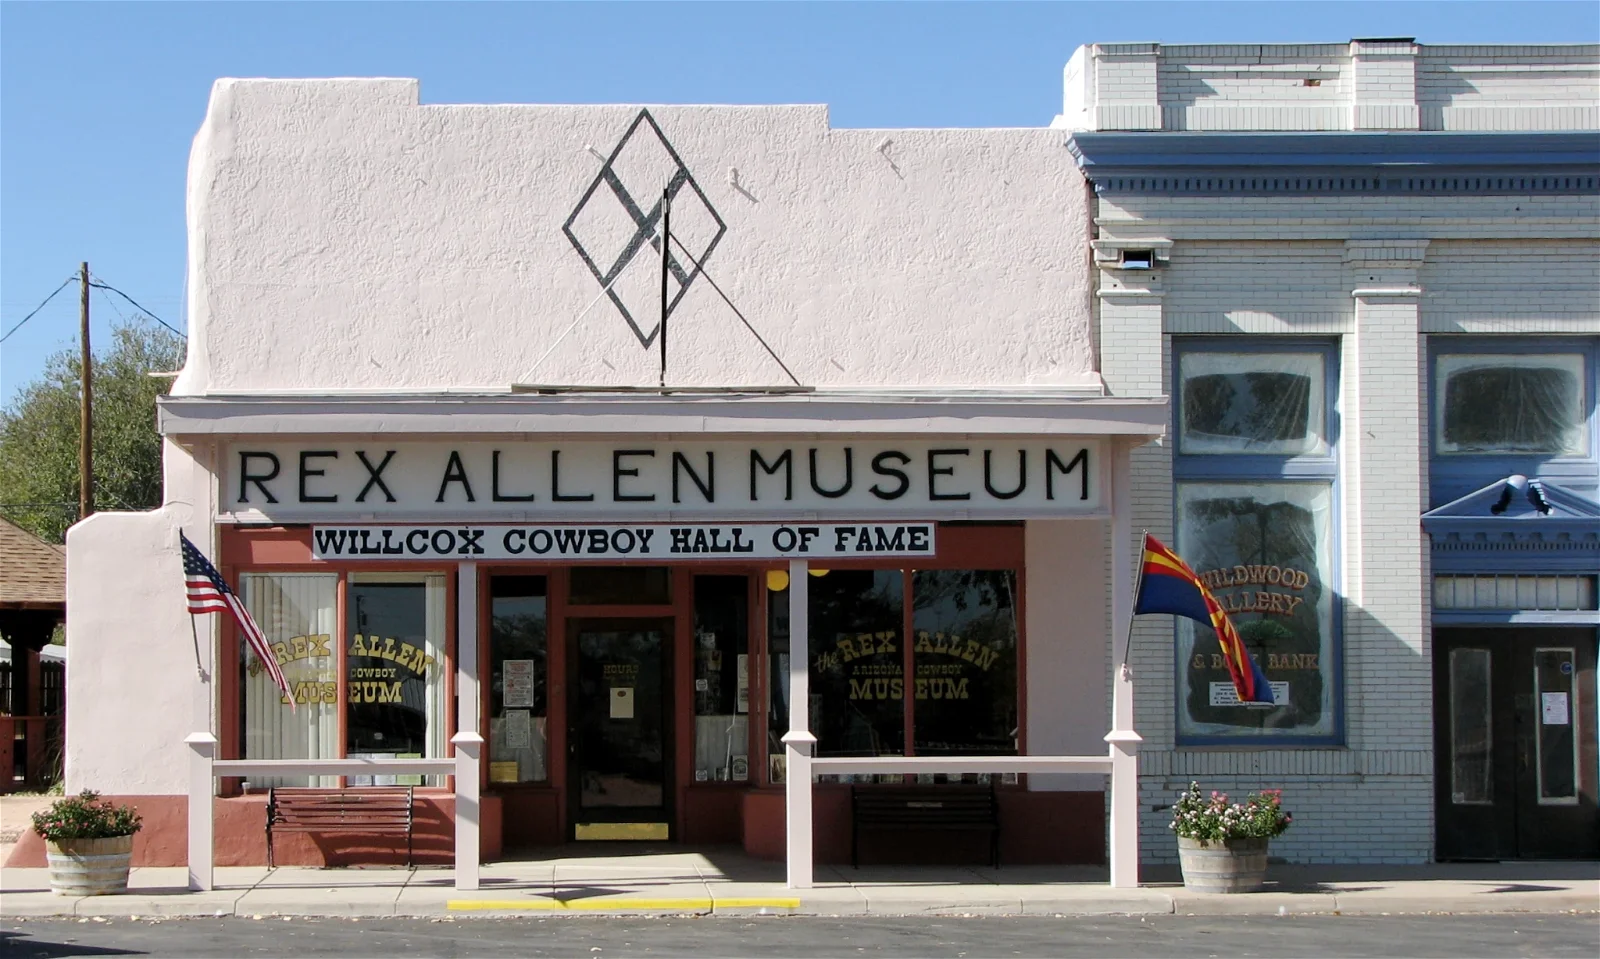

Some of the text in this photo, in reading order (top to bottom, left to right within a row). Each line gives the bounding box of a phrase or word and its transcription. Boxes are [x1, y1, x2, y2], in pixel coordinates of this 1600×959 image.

[237, 447, 1089, 503] REX ALLEN MUSEUM
[314, 526, 929, 554] WILLCOX COWBOY HALL OF FAME
[1214, 591, 1303, 616] ALLERY
[270, 633, 331, 667] REX
[347, 633, 435, 676] ALLEN
[814, 630, 999, 673] the REX ALLEN
[1267, 653, 1319, 669] BANK
[351, 668, 397, 678] COWBOY
[852, 664, 963, 676] ARIZONA COWBOY
[280, 681, 403, 704] MUSEUM
[849, 678, 969, 700] MUSEUM
